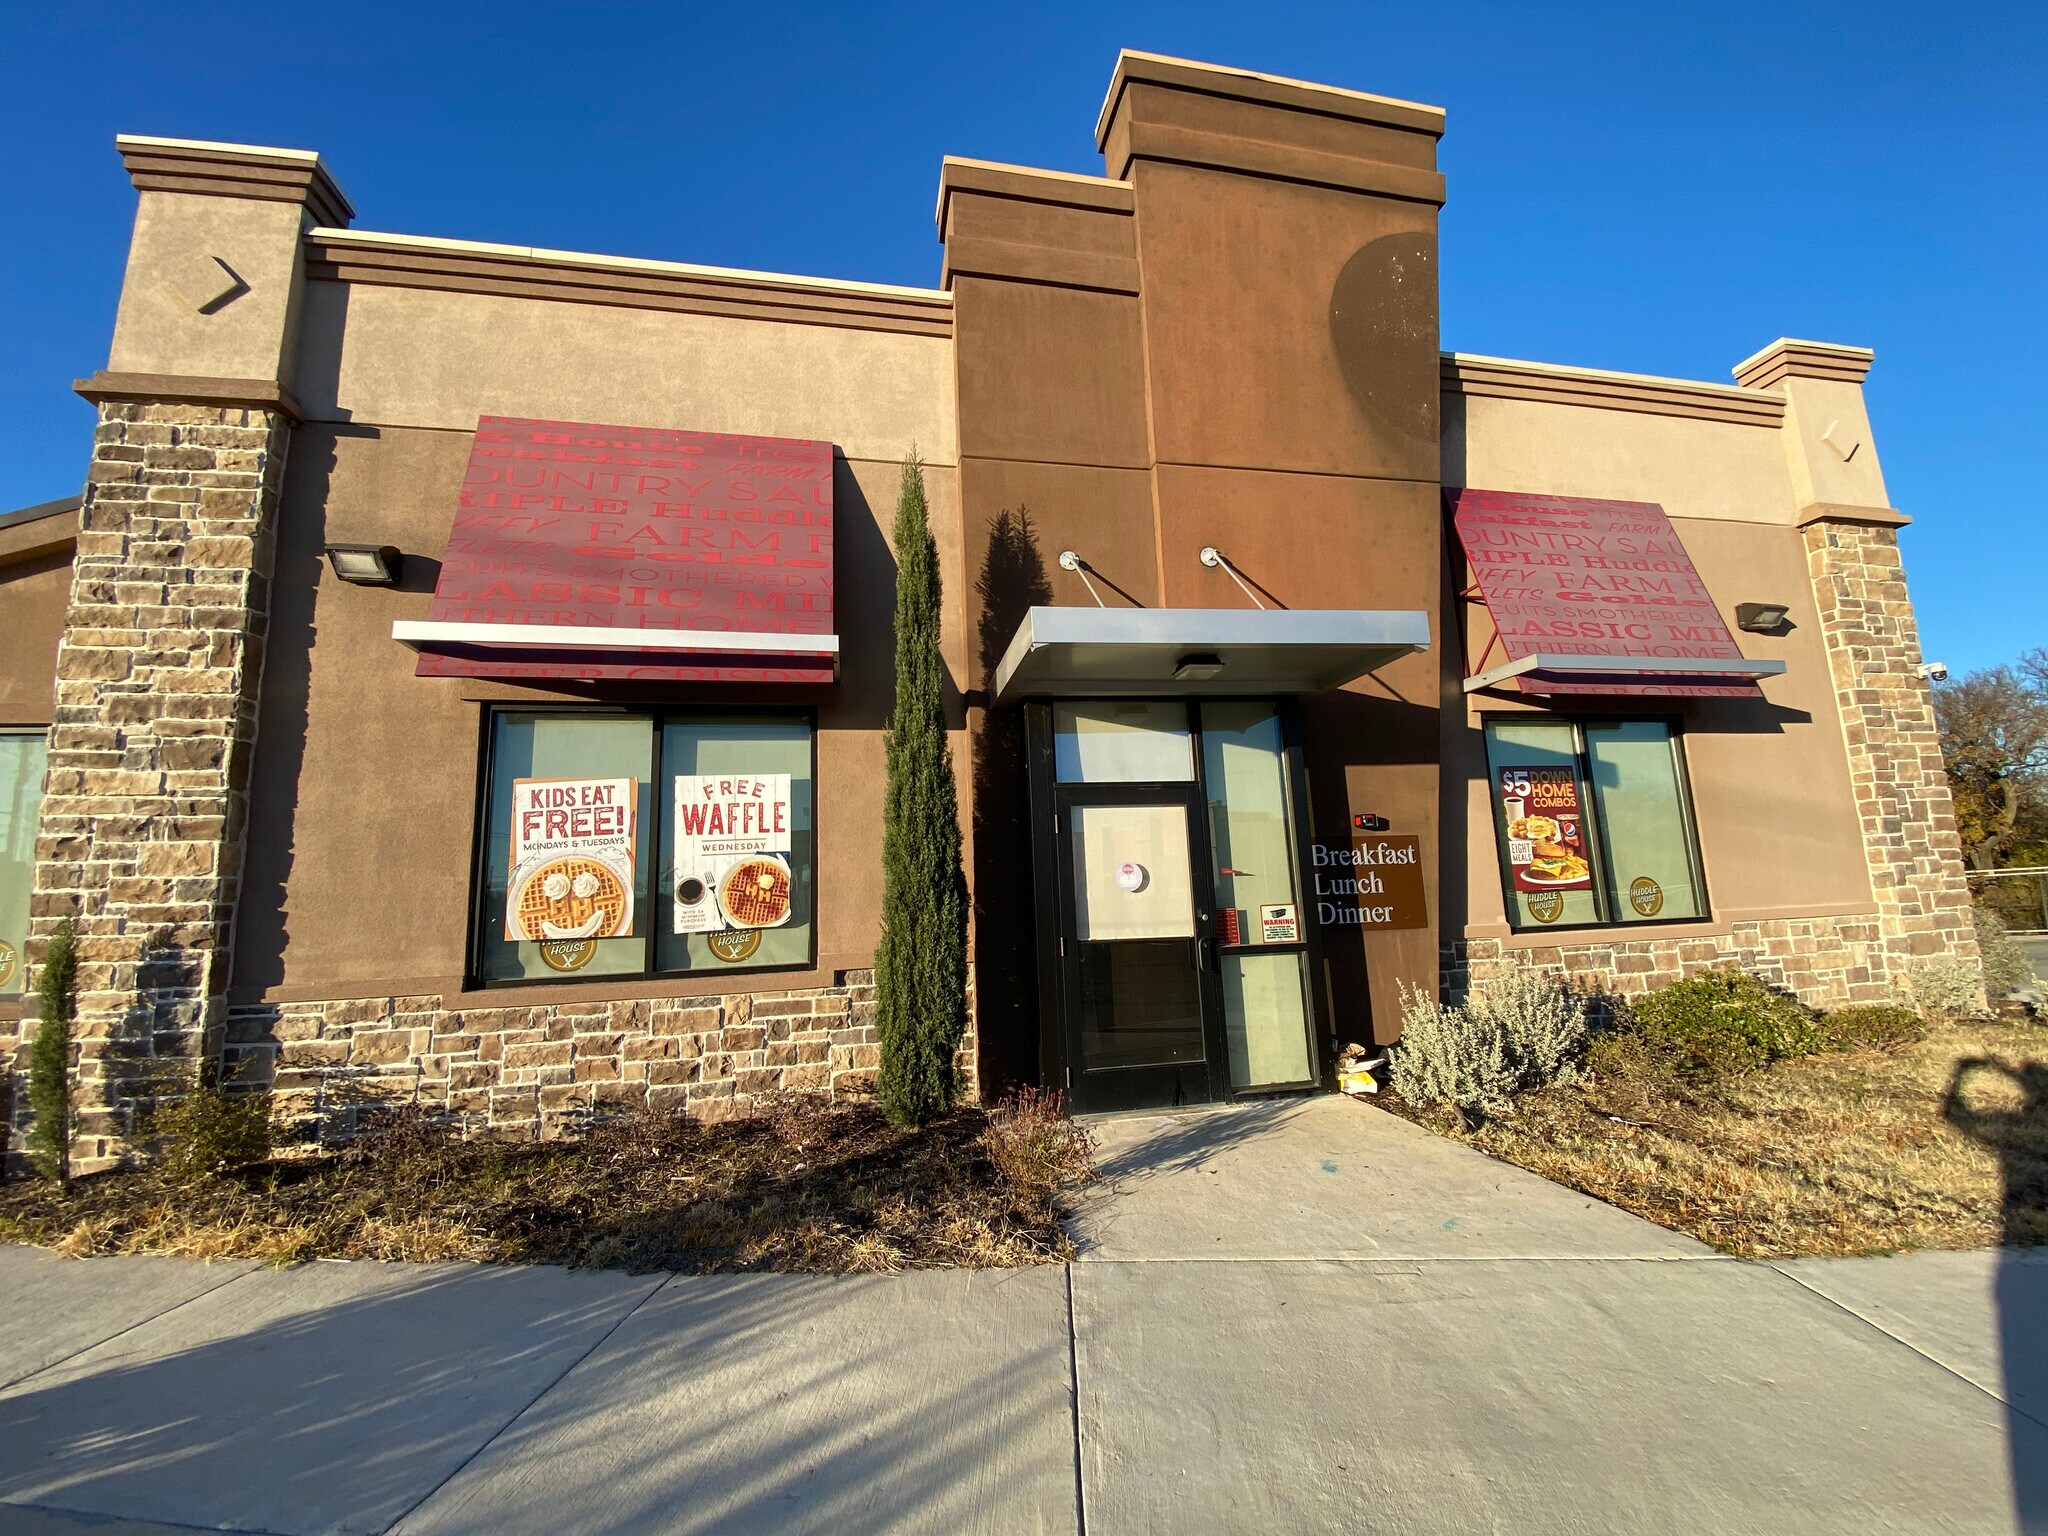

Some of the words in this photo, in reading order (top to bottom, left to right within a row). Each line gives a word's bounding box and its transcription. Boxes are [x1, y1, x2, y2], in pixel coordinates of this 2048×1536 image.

[473, 448, 701, 470] eakfast
[585, 521, 781, 551] FARM
[1608, 522, 1660, 535] FARM
[570, 564, 807, 587] SMOTHERED
[1554, 571, 1676, 594] FARM
[1555, 591, 1712, 607] Golde
[1563, 607, 1704, 622] SMOTHERED
[703, 780, 766, 800] FREE
[1503, 771, 1531, 797] $5
[1530, 771, 1573, 783] DOWN
[1531, 783, 1575, 797] HOME
[531, 787, 576, 809] KIDS
[581, 785, 615, 806] EAT
[1533, 797, 1577, 808] COMBOS
[523, 806, 624, 840] FREE!
[682, 802, 786, 835] WAFFLE
[523, 841, 569, 851] MONDAYS
[572, 840, 579, 848] &
[582, 837, 625, 847] TUESDAYS
[702, 842, 767, 852] WEDNESDAY
[1511, 843, 1531, 854] EIGHT
[1312, 842, 1417, 866] Breakfast
[1513, 854, 1532, 862] MEALS
[1314, 871, 1385, 895] Lunch
[1528, 891, 1558, 903] HUDDLE
[1630, 885, 1660, 897] HUDDLE
[1535, 901, 1556, 910] HOUSE
[1636, 895, 1657, 904] HOUSE
[1317, 901, 1394, 925] Dinner
[718, 934, 751, 946] HOUSE
[551, 942, 586, 955] HOUSE
